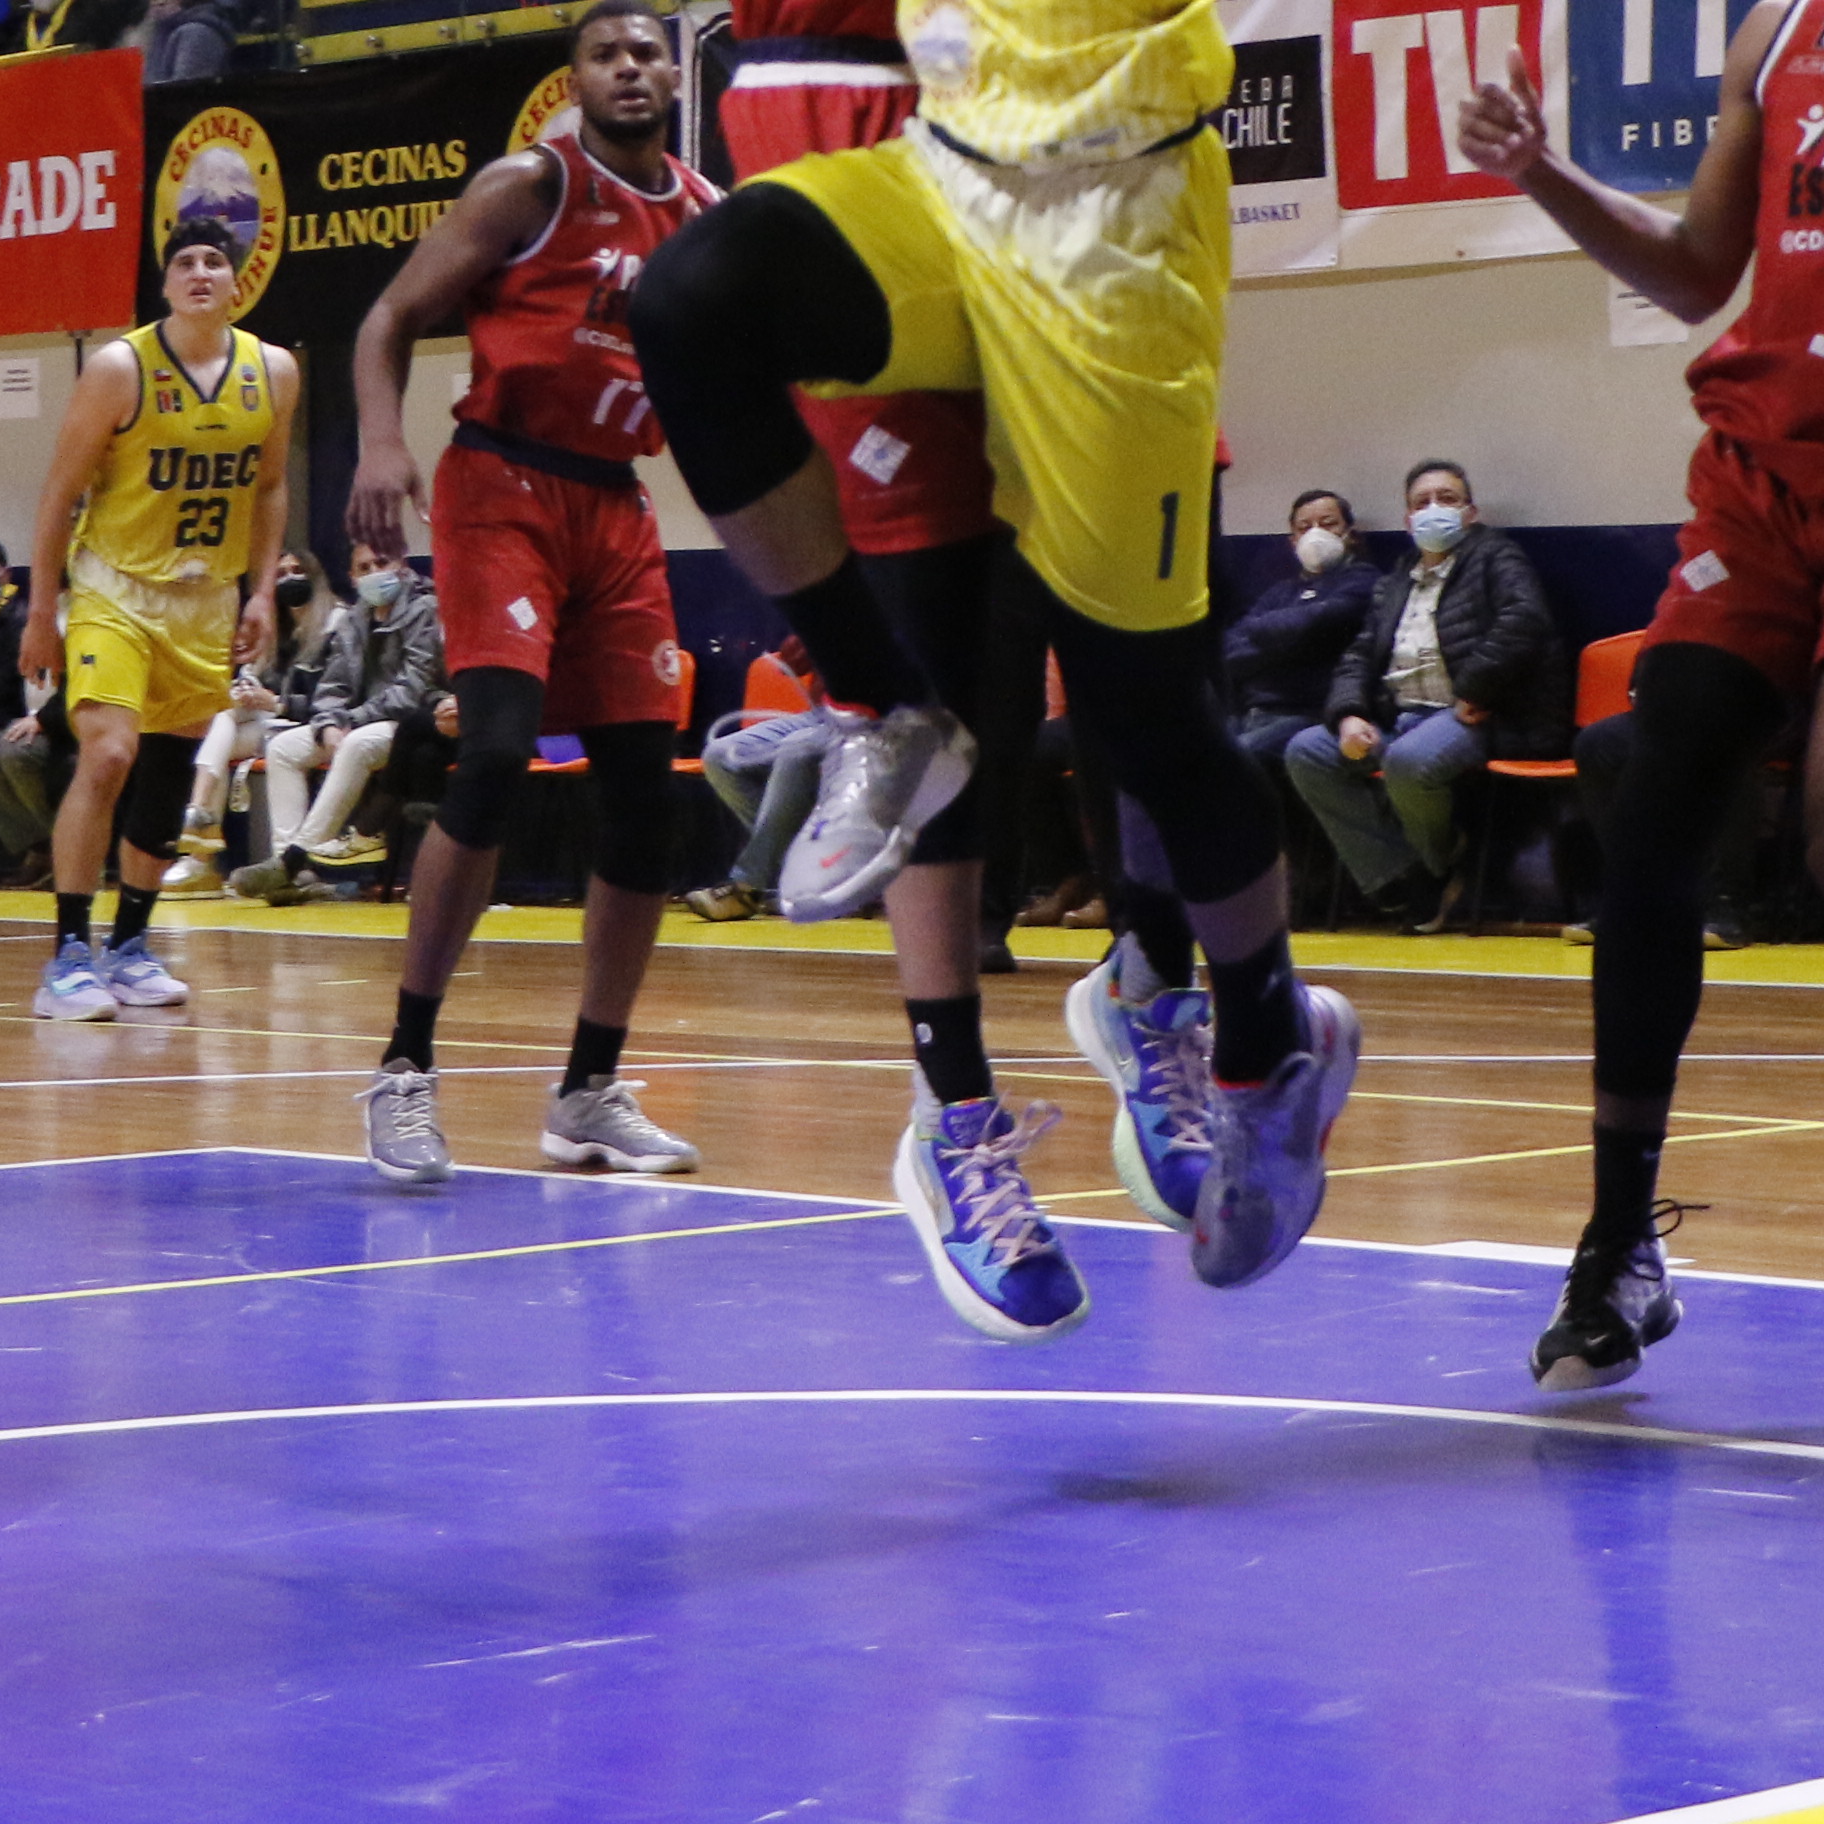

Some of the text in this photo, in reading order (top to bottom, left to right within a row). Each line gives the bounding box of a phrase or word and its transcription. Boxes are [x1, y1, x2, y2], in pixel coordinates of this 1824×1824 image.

[1223, 102, 1293, 150] CHILE
[318, 139, 467, 192] CECINAS
[174, 497, 230, 547] 23
[1158, 491, 1179, 579] 1
